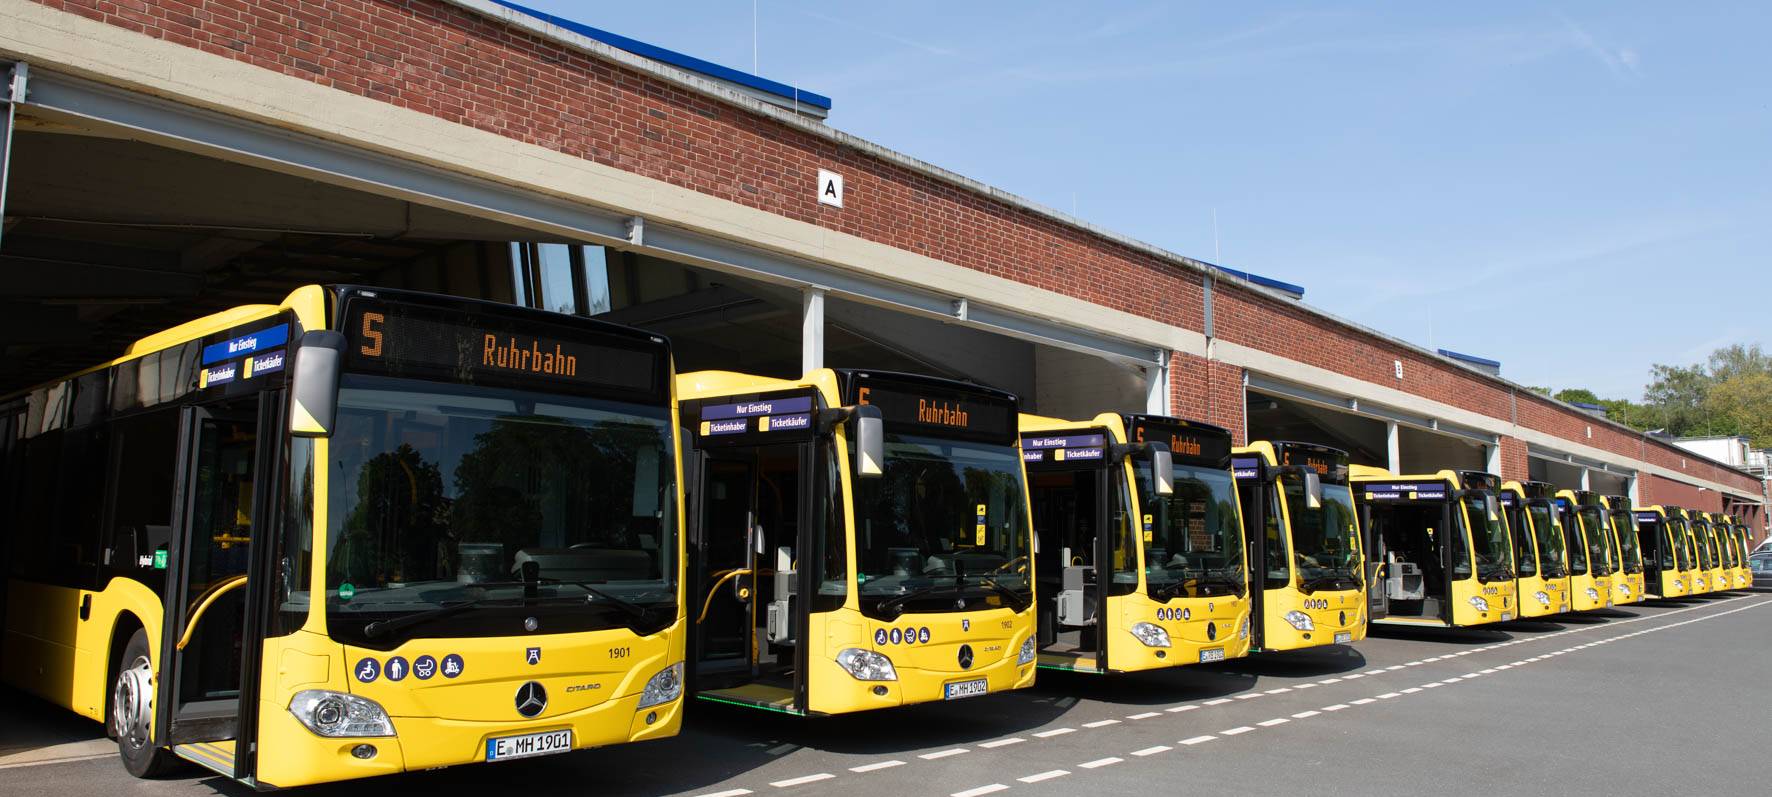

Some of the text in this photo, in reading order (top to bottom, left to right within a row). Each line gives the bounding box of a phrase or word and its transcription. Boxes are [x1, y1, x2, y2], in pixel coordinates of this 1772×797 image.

[825, 179, 836, 198] A
[228, 337, 258, 353] Nur Einstieg
[361, 312, 577, 377] S Ruhrbahn
[736, 403, 772, 414] Nur Einstieg
[919, 398, 968, 427] Ruhrbahn
[710, 422, 746, 433] Ticketinhaber
[771, 417, 808, 428] Ticketkäufer
[1032, 438, 1067, 447] Nur Einstieg
[1171, 434, 1201, 457] Ruhrbahn
[1066, 449, 1100, 458] Ticketkäufer
[608, 647, 631, 659] 1901
[565, 683, 602, 693] CITARO
[950, 685, 954, 696] E
[969, 681, 986, 693] 1902
[497, 733, 569, 756] E MH 1901
